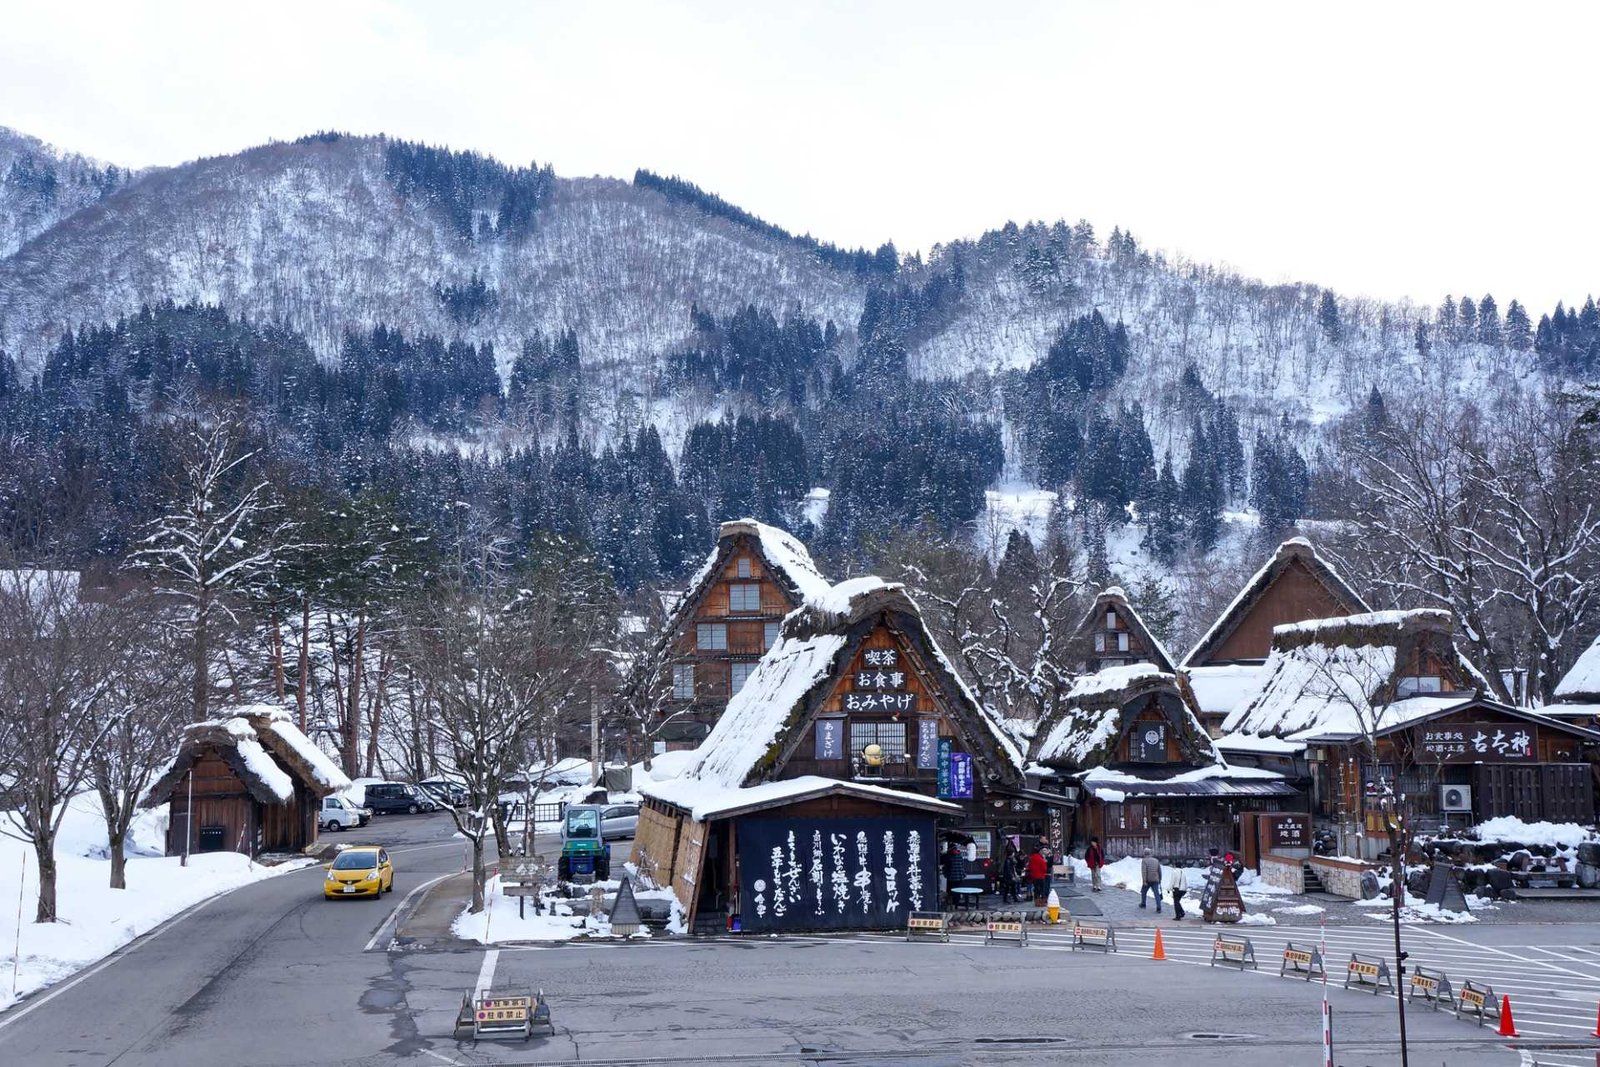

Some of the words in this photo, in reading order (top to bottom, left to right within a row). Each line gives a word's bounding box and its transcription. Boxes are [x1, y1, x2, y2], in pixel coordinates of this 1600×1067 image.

[864, 650, 896, 666] 喫茶
[858, 672, 904, 688] お食事
[846, 694, 914, 710] おみやげ
[824, 721, 835, 758] あまざけ
[1425, 732, 1464, 741] お食事処
[883, 830, 900, 913] 飛騨牛コロッケ
[994, 922, 1020, 931] 駐車禁止
[487, 1011, 523, 1019] 駐車禁止
